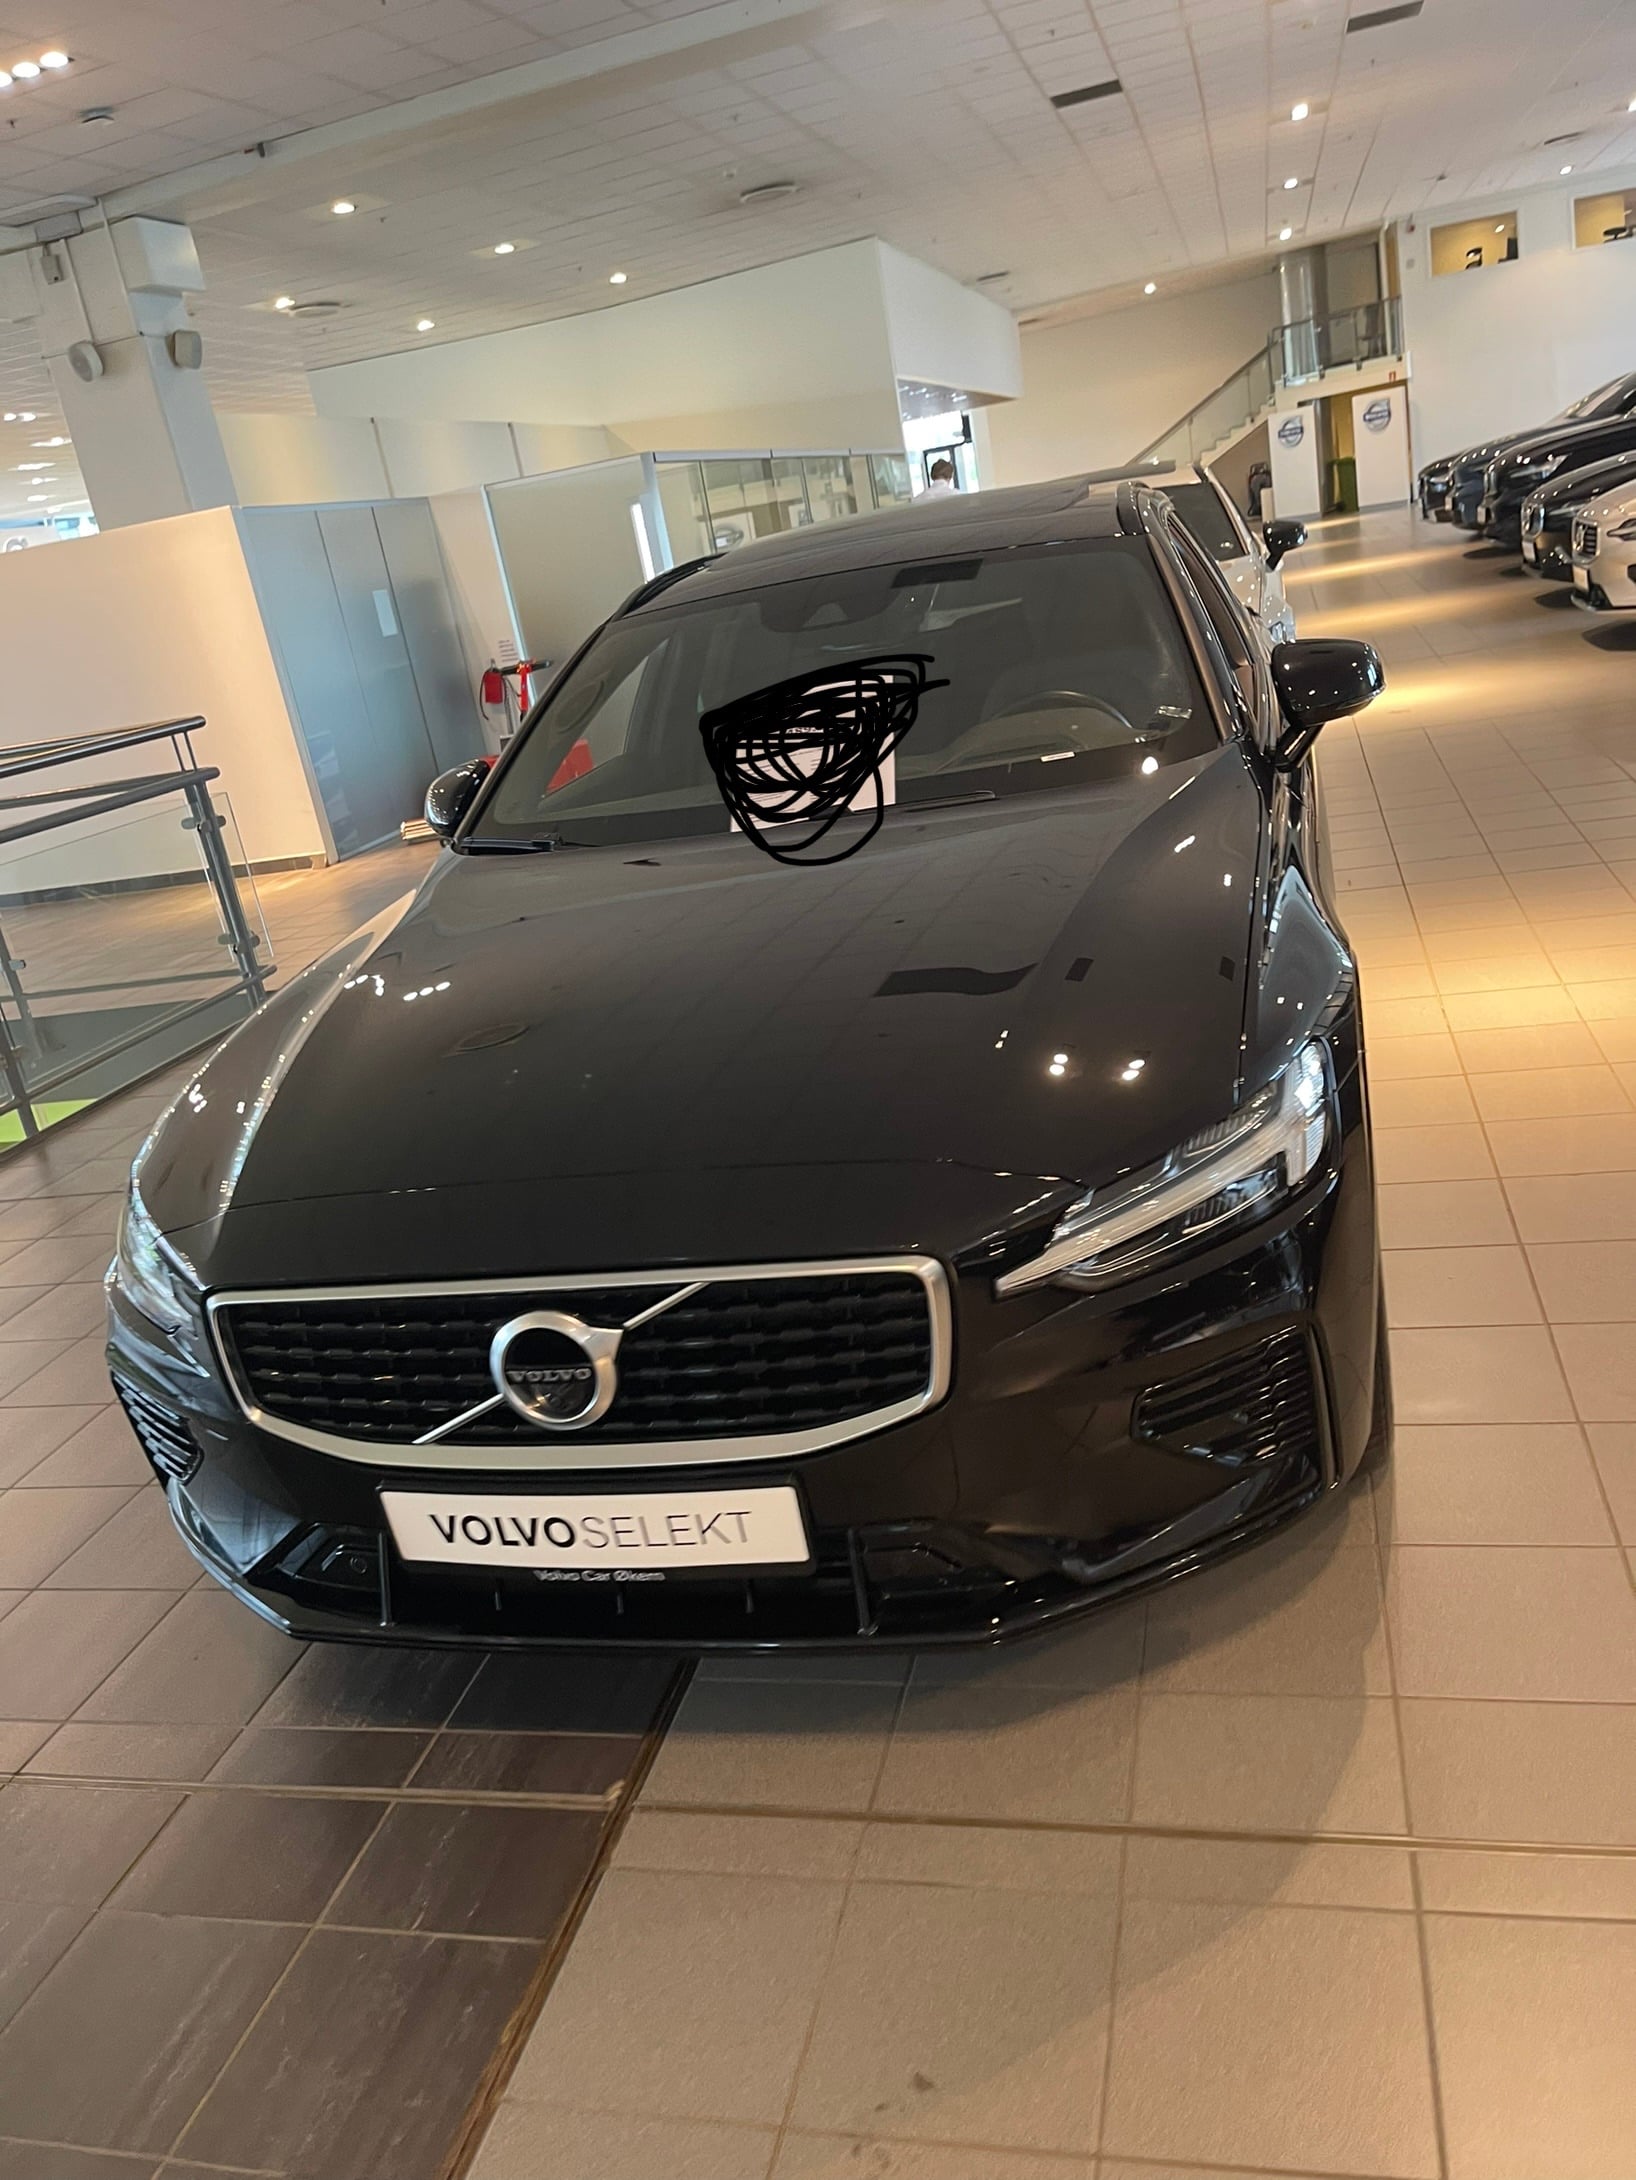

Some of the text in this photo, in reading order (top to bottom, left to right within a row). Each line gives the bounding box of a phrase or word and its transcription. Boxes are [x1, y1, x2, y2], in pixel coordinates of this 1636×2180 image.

[506, 1368, 592, 1383] VOLVO
[532, 1569, 580, 1581] Volvo
[581, 1569, 611, 1581] Car
